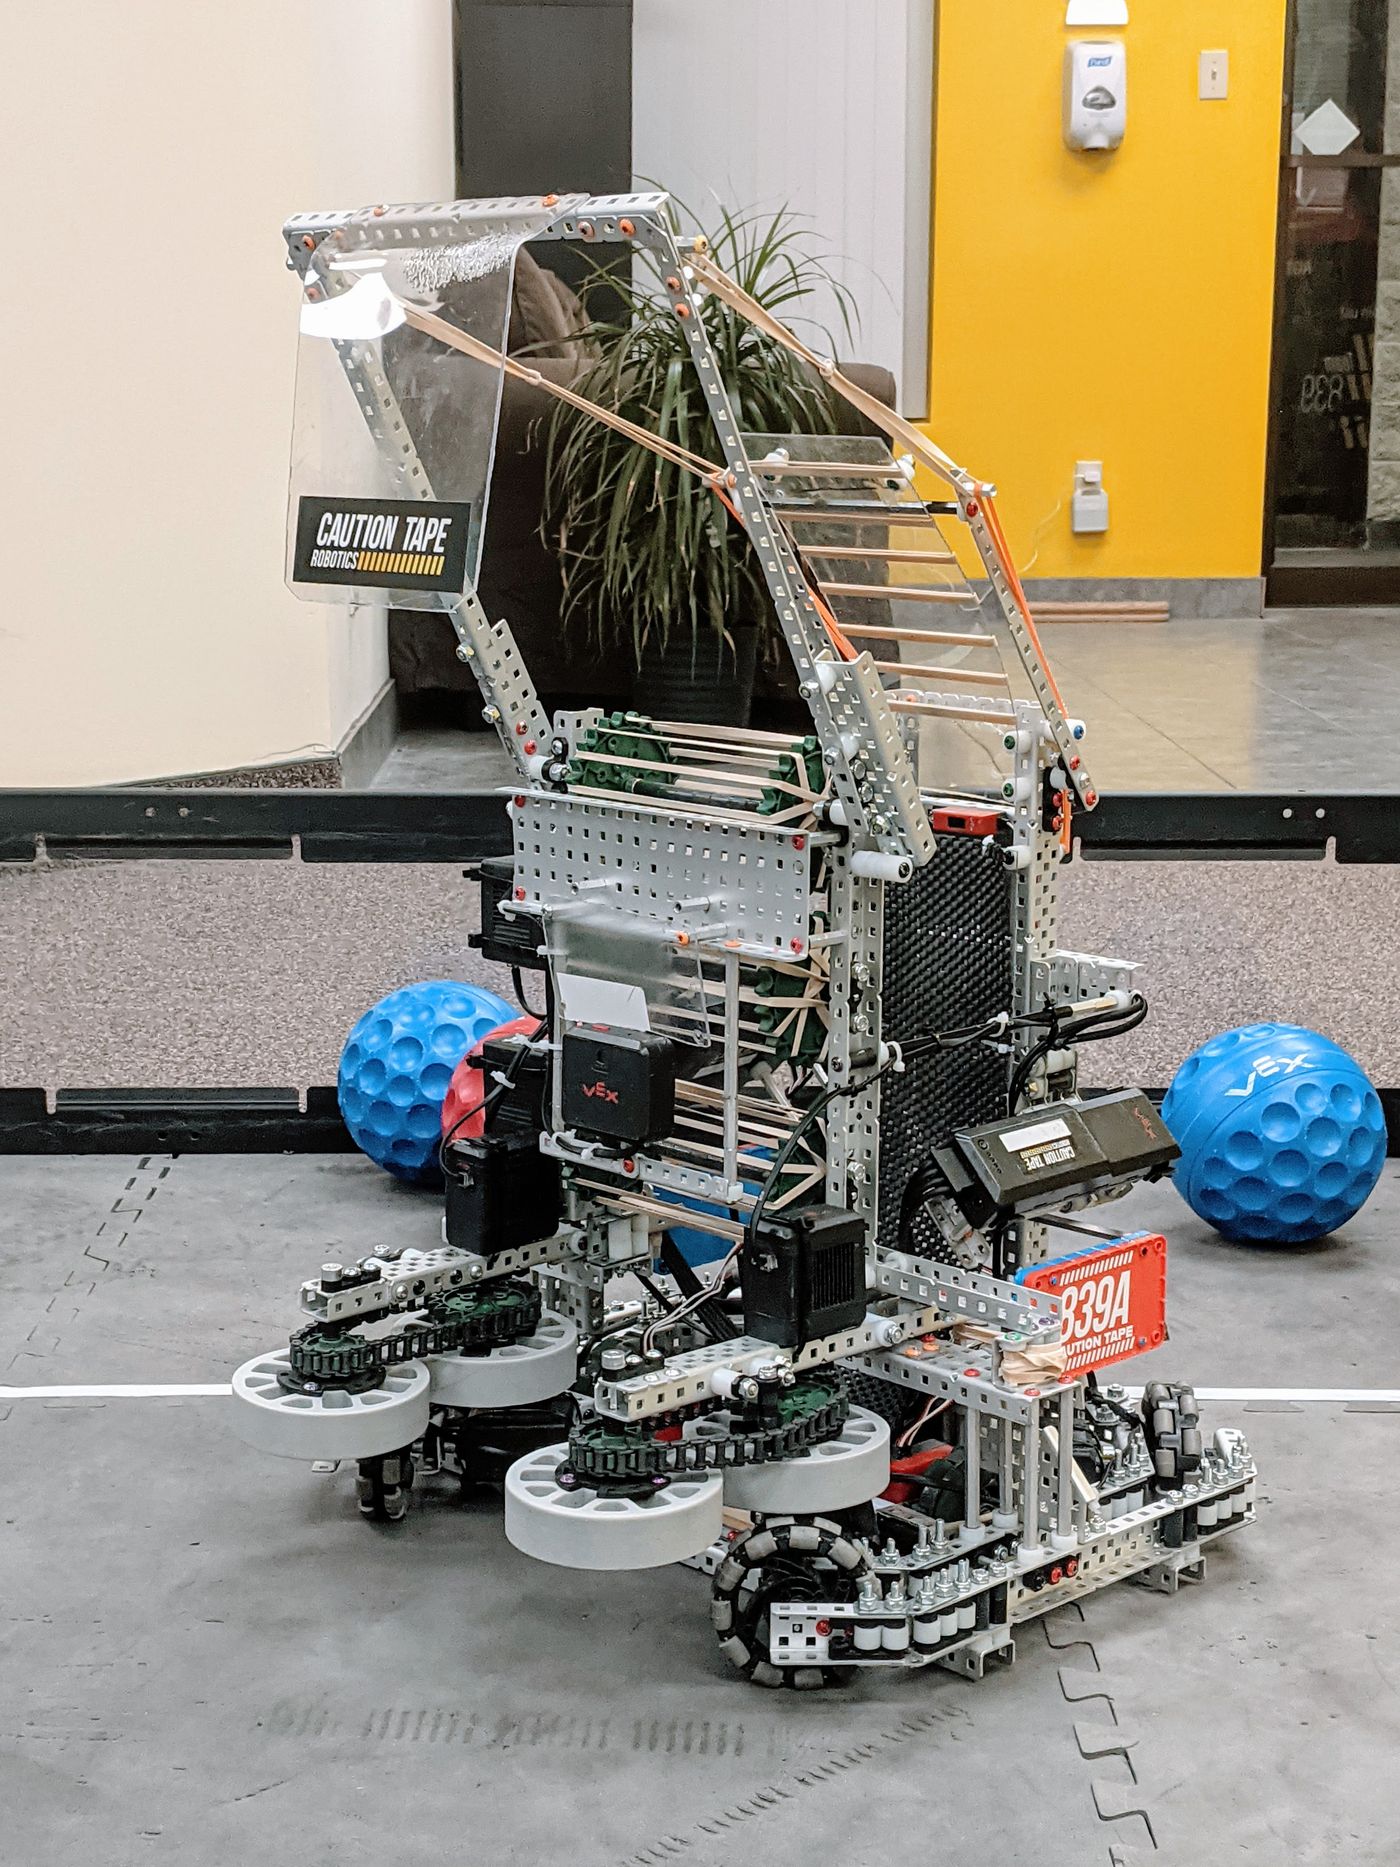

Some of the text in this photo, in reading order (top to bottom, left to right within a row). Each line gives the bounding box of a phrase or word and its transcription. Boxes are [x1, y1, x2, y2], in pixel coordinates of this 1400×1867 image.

[316, 512, 452, 553] CAUTION TAPE
[310, 549, 359, 570] ROBOTICS
[1224, 1053, 1315, 1097] VEX
[581, 1081, 619, 1105] VEX
[1024, 1146, 1075, 1171] CAUTION TAPE
[1060, 1270, 1131, 1343] 839A
[1063, 1325, 1134, 1357] UTION TAPE
